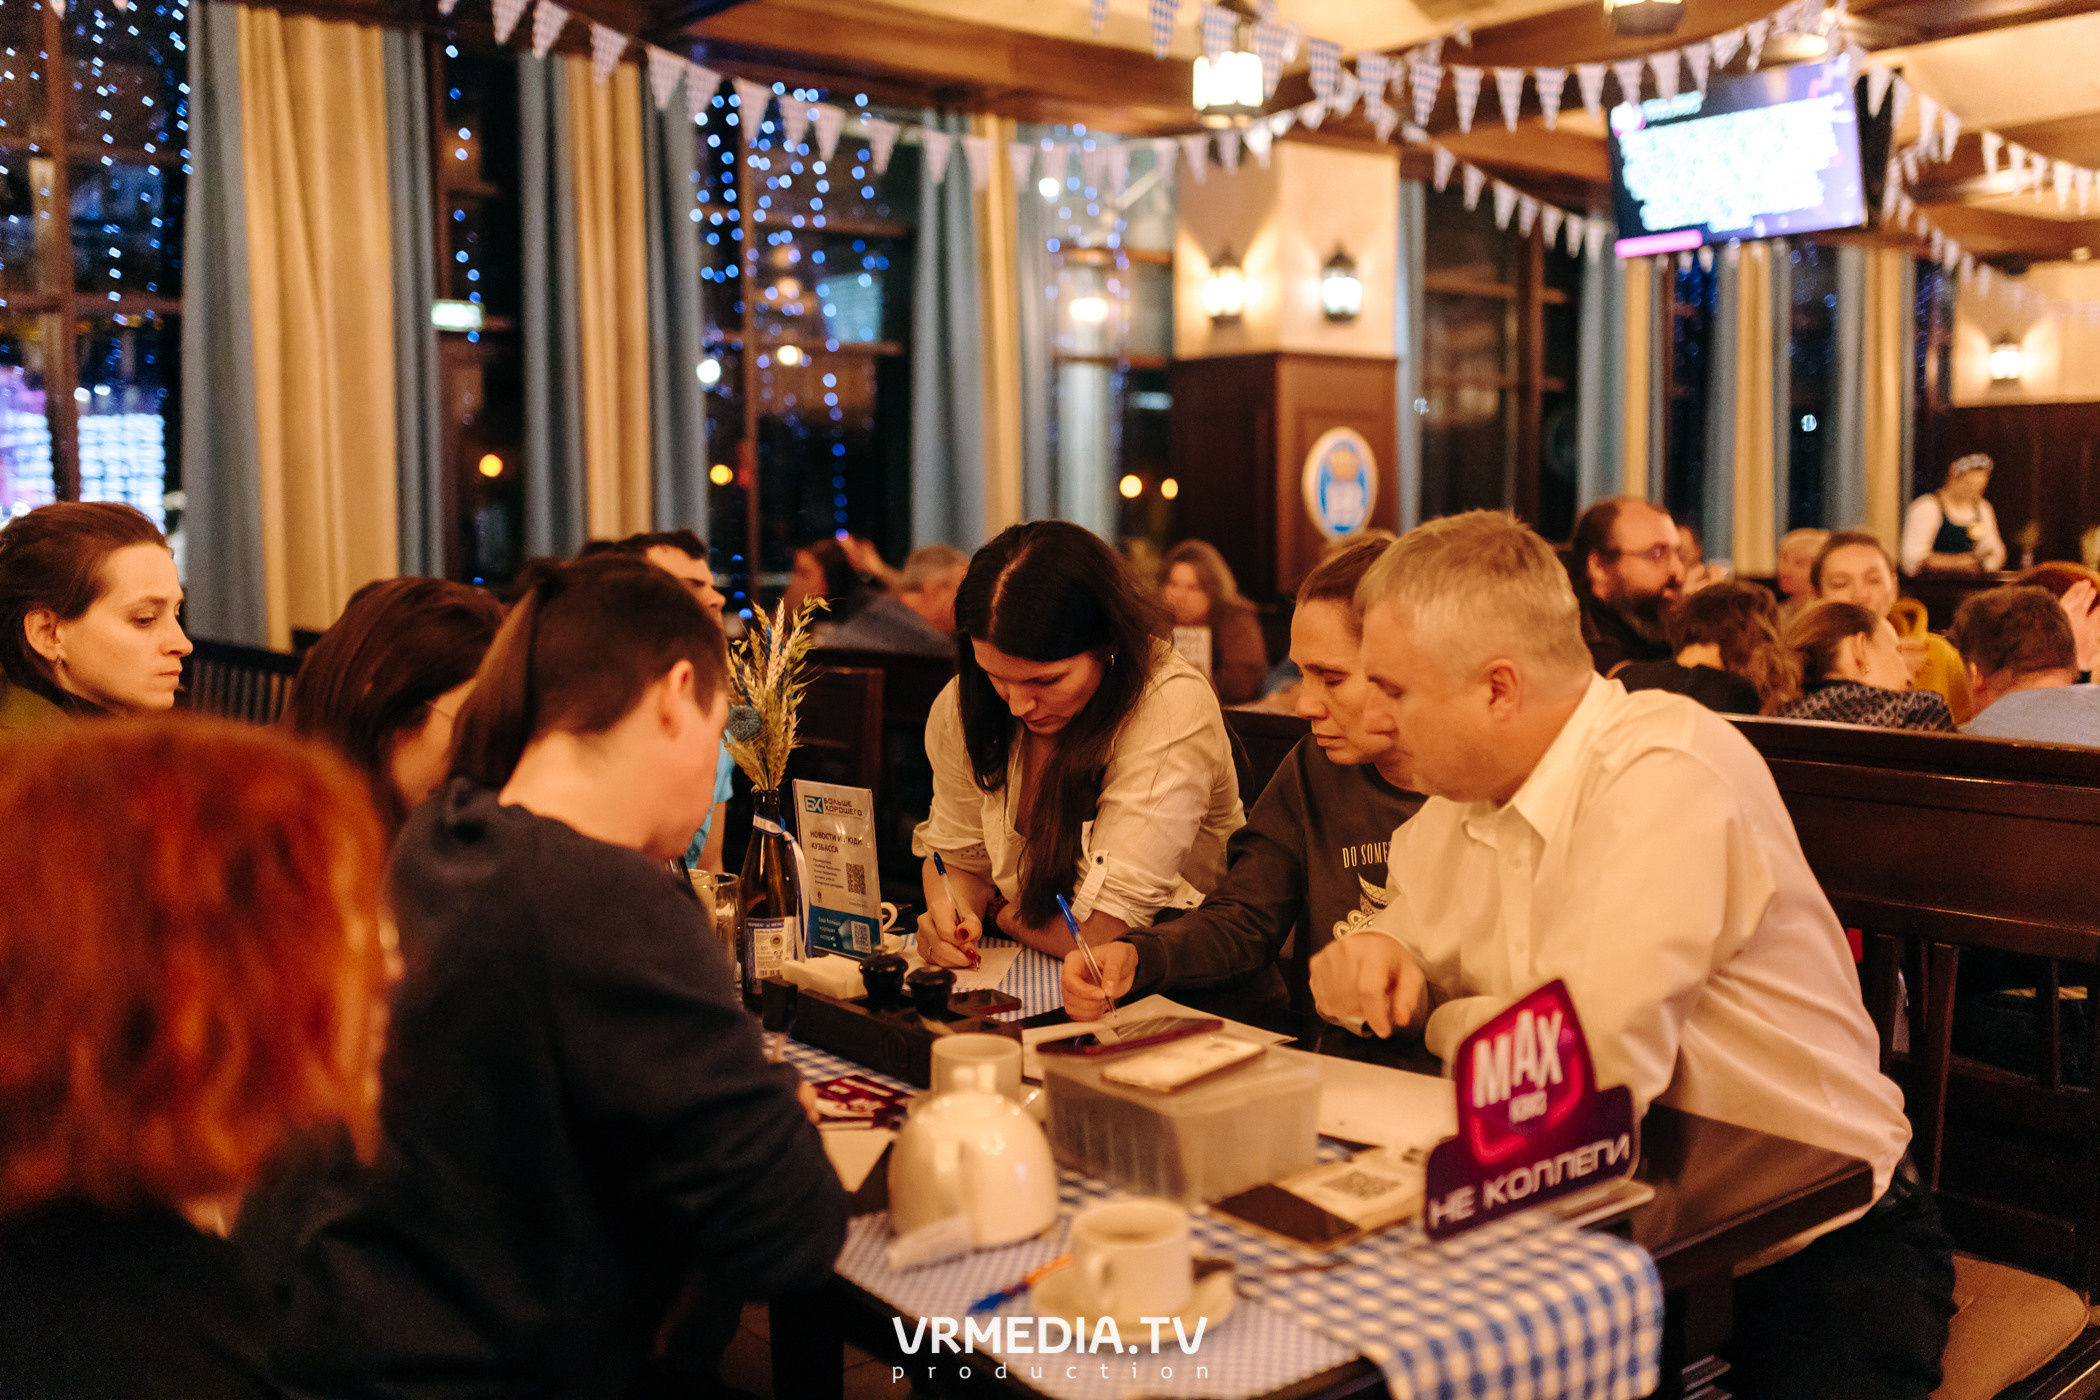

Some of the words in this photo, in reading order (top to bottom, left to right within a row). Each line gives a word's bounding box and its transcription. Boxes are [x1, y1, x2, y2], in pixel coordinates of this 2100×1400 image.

[824, 797, 853, 808] БОЛЬШЕ
[824, 805, 863, 817] ХОРОШЕГО
[810, 830, 837, 842] НОВОСТИ
[811, 842, 839, 854] КУЗБАССА
[1342, 845, 1358, 869] DO
[1361, 841, 1391, 866] SOME
[1472, 1009, 1563, 1109] MAX
[1428, 1185, 1476, 1229] НЕ
[1483, 1132, 1630, 1210] КОЛЛЕГИ
